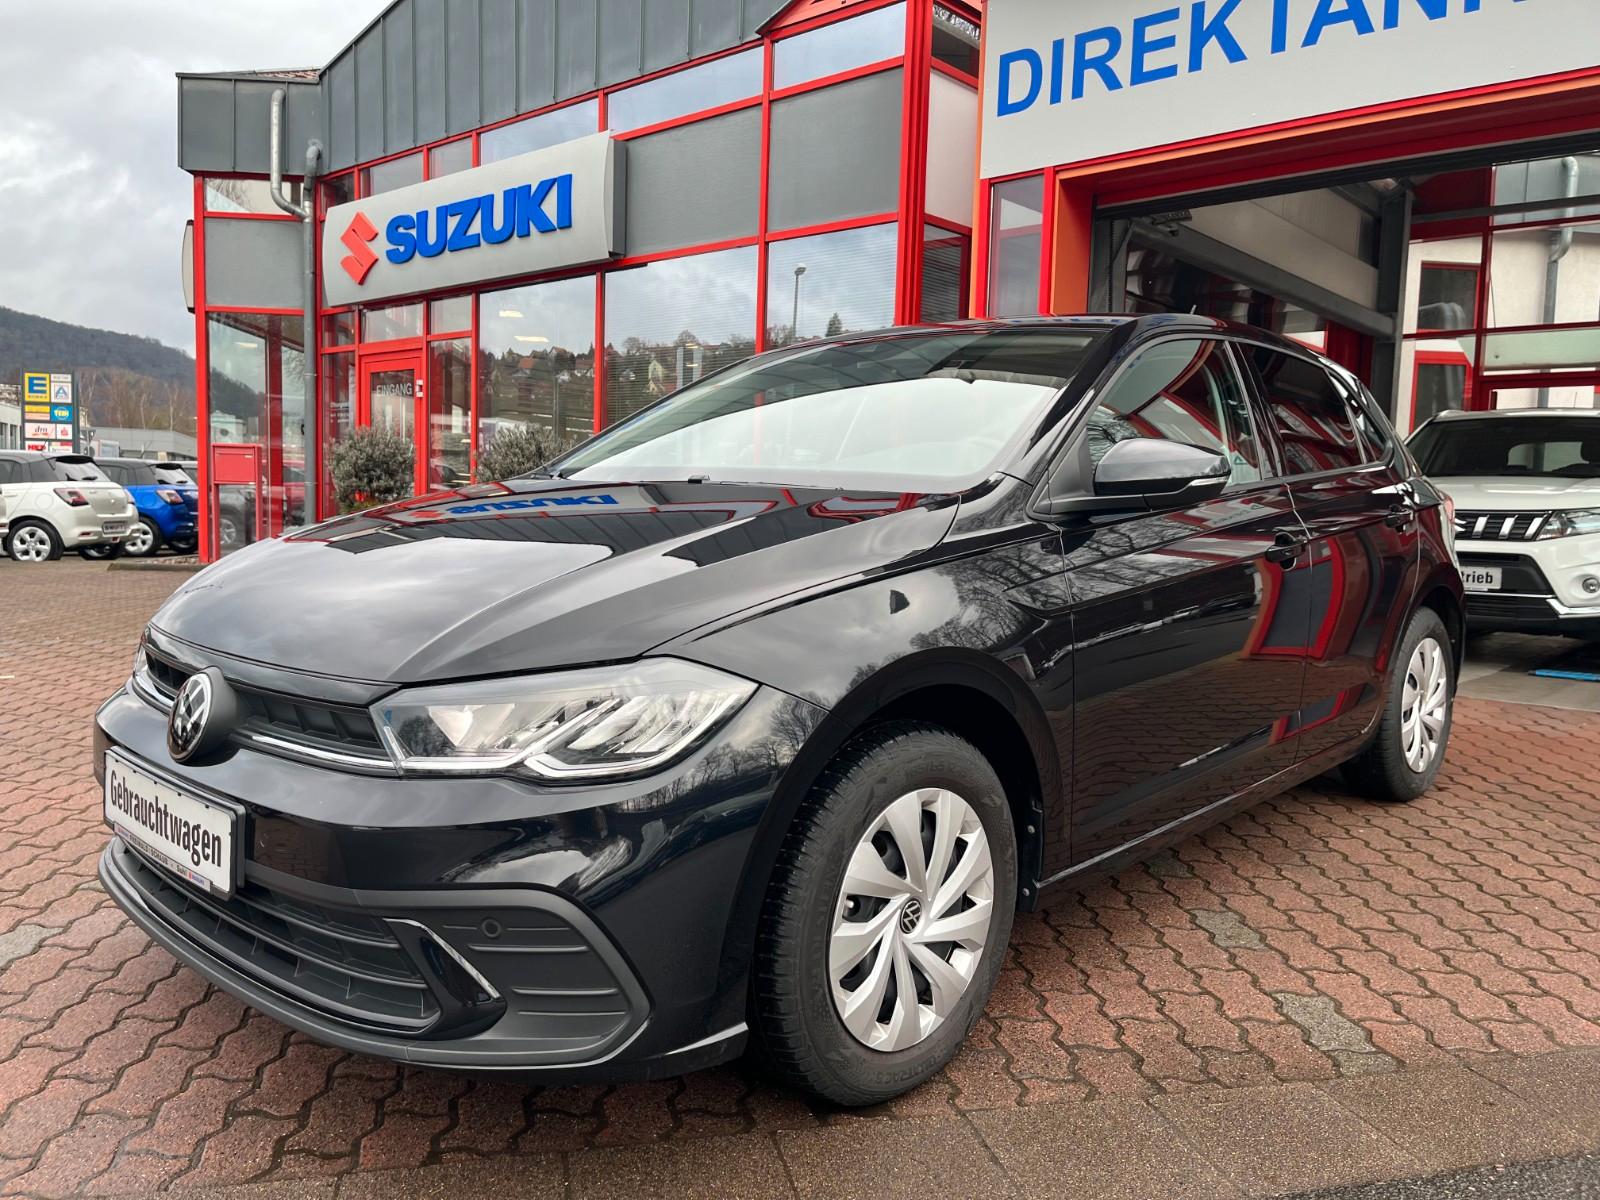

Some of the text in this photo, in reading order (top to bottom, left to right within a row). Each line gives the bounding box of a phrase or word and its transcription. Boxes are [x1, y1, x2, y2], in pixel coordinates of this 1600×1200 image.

[997, 0, 1529, 116] DIREKTA
[385, 173, 573, 265] SUZUKI
[376, 383, 413, 397] EINGANG
[110, 769, 222, 868] Gebrauchtwagen
